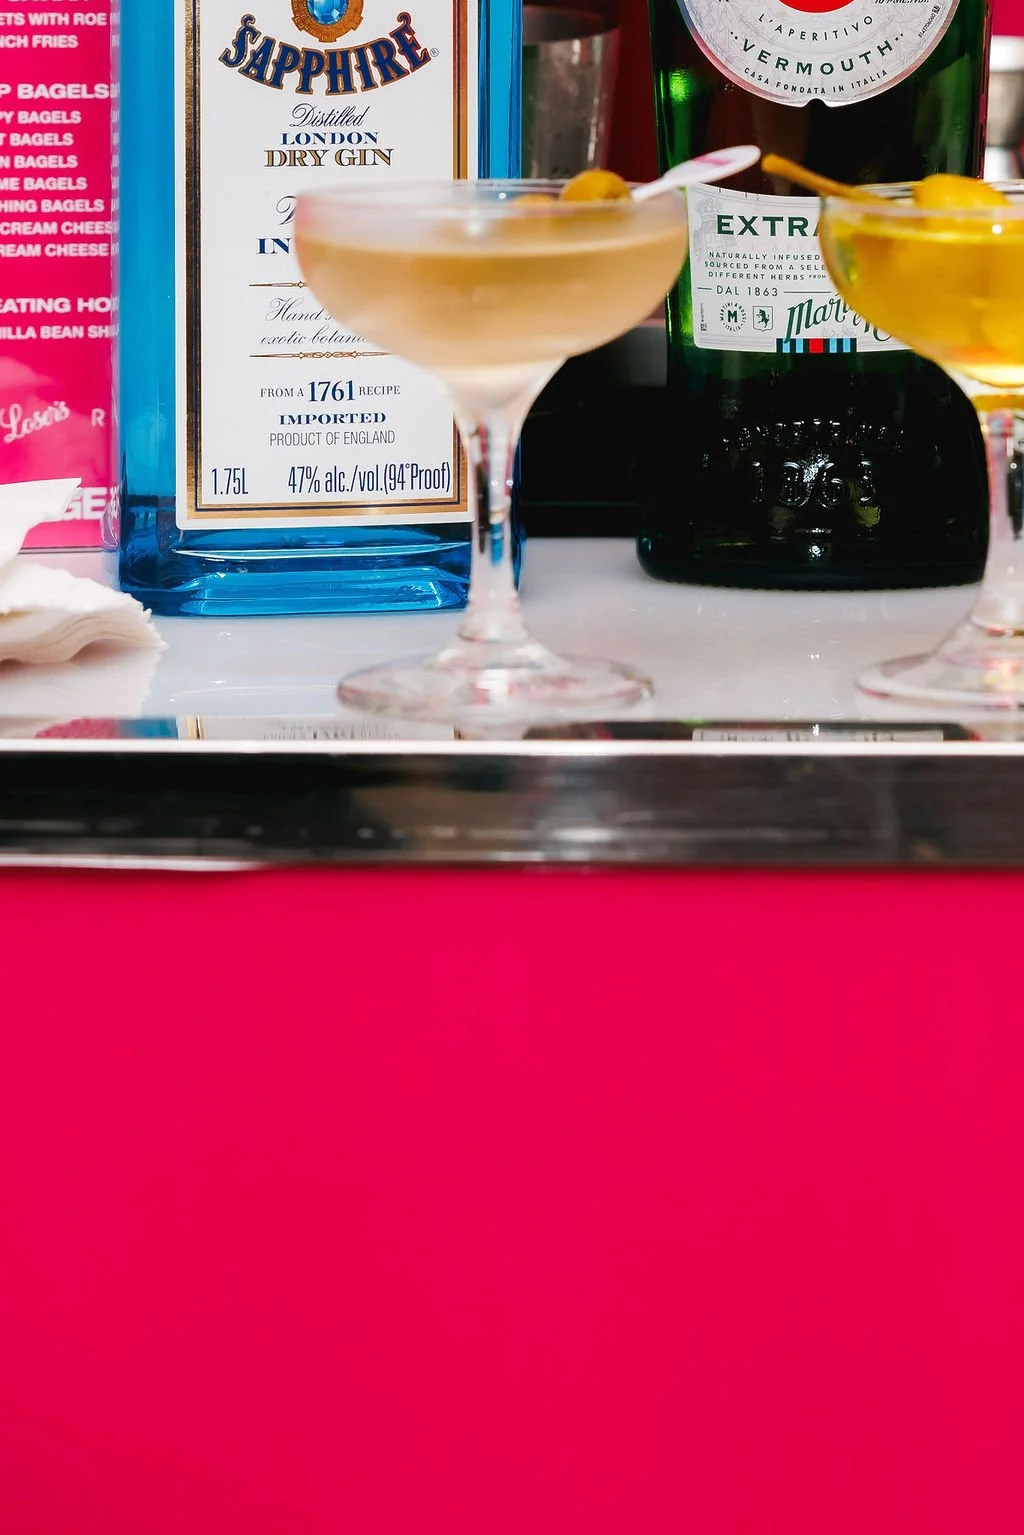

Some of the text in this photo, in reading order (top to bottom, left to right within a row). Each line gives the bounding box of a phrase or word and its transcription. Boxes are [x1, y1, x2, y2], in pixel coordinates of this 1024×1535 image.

[28, 12, 70, 26] WITH
[73, 12, 107, 26] ROE
[32, 34, 78, 48] FRIES
[218, 11, 431, 96] SAPPHIRE
[742, 39, 893, 76] VERMOUTH
[744, 67, 770, 84] CASA
[776, 81, 826, 94] FONDATA
[851, 69, 888, 89] ITALIA
[17, 83, 109, 99] BAGELS
[18, 110, 82, 124] BAGELS
[289, 102, 371, 127] Distilled
[10, 133, 74, 146] BAGELS
[280, 131, 380, 146] LONDON
[14, 155, 78, 168] BAGELS
[264, 148, 395, 167] DRY GIN
[23, 177, 87, 191] BAGELS
[41, 199, 104, 212] BAGELS
[0, 221, 57, 235] CREAM
[716, 214, 820, 237] EXTR
[45, 243, 109, 257] CHEESE
[709, 251, 768, 260] NATURALLY
[705, 261, 749, 270] SOURCED
[708, 271, 765, 280] DIFFERENT
[716, 285, 778, 297] DAL 1863
[265, 297, 325, 322] Hand
[727, 310, 738, 323] M
[40, 325, 84, 339] BEAN
[260, 331, 307, 345] exotic
[260, 380, 401, 402] FROM A 1761 RECIPE
[279, 412, 387, 425] IMPORTED
[269, 430, 396, 447] PRODUCT OF ENGLAND
[211, 467, 249, 495] 1.75L
[288, 465, 321, 494] 47%
